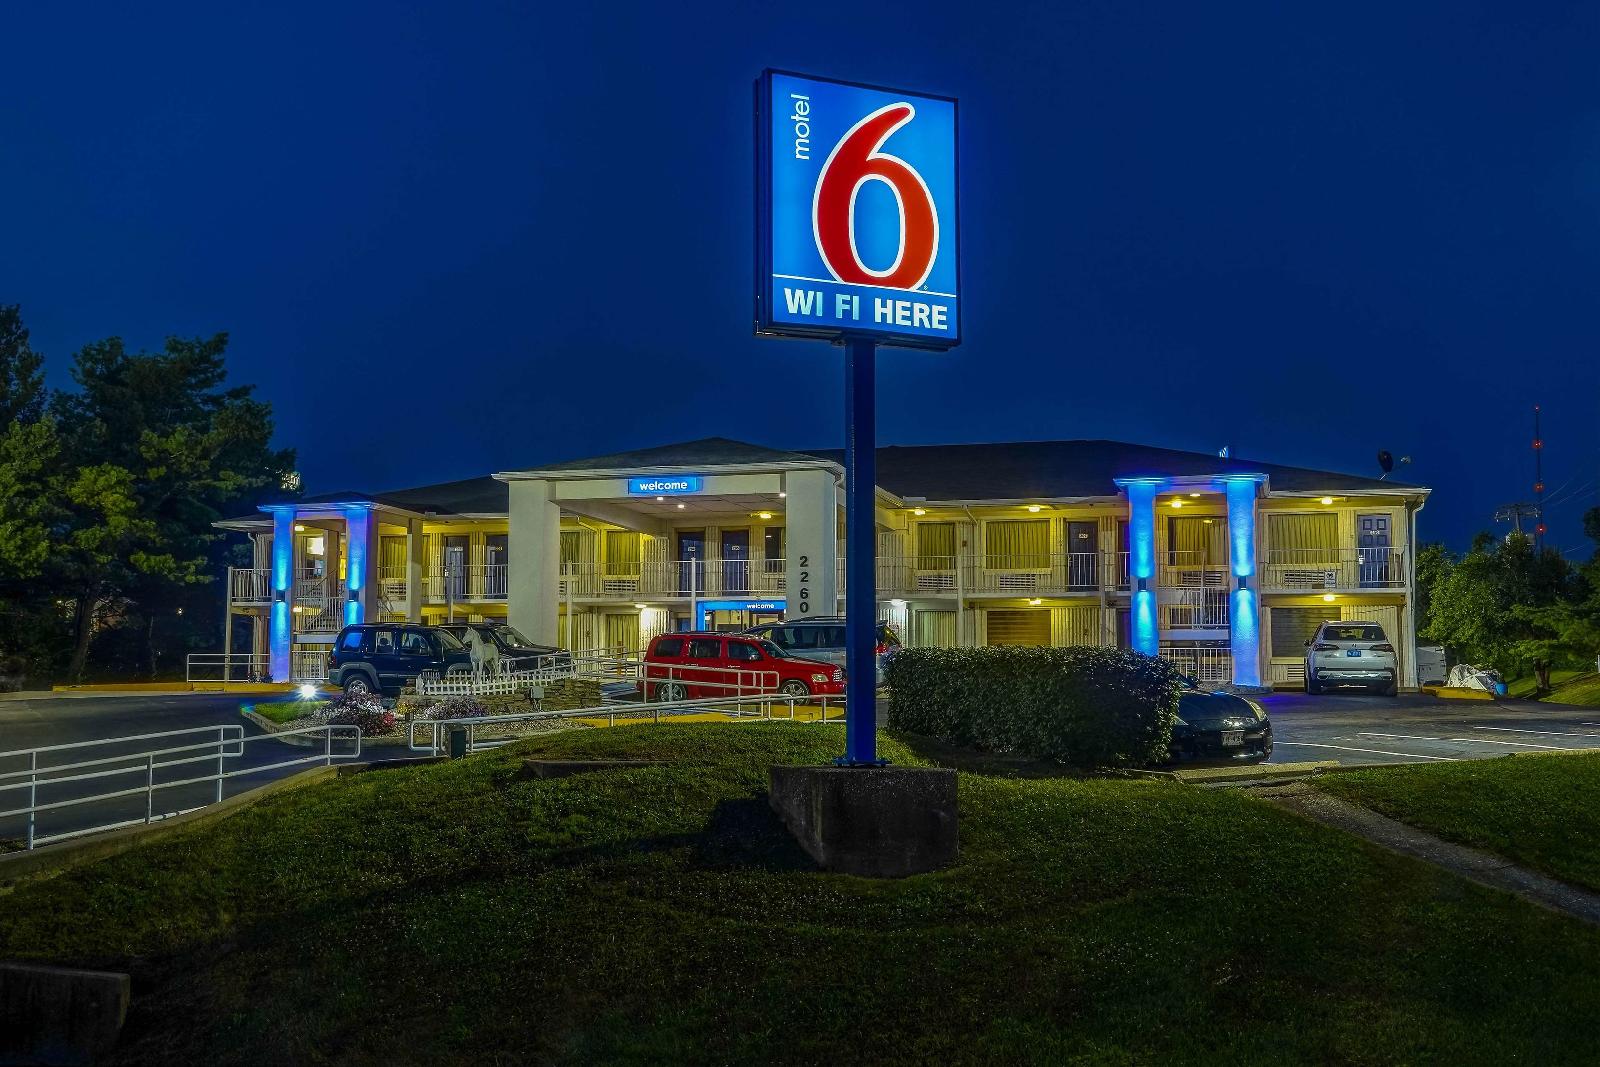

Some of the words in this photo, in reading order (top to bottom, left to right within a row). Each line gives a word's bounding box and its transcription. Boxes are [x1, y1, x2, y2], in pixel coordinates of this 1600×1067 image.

[791, 94, 810, 160] motel
[812, 101, 940, 291] 6
[783, 287, 823, 317] WI
[835, 293, 860, 321] FI
[874, 297, 948, 330] HERE
[639, 481, 688, 491] welcome
[799, 555, 809, 613] 2260
